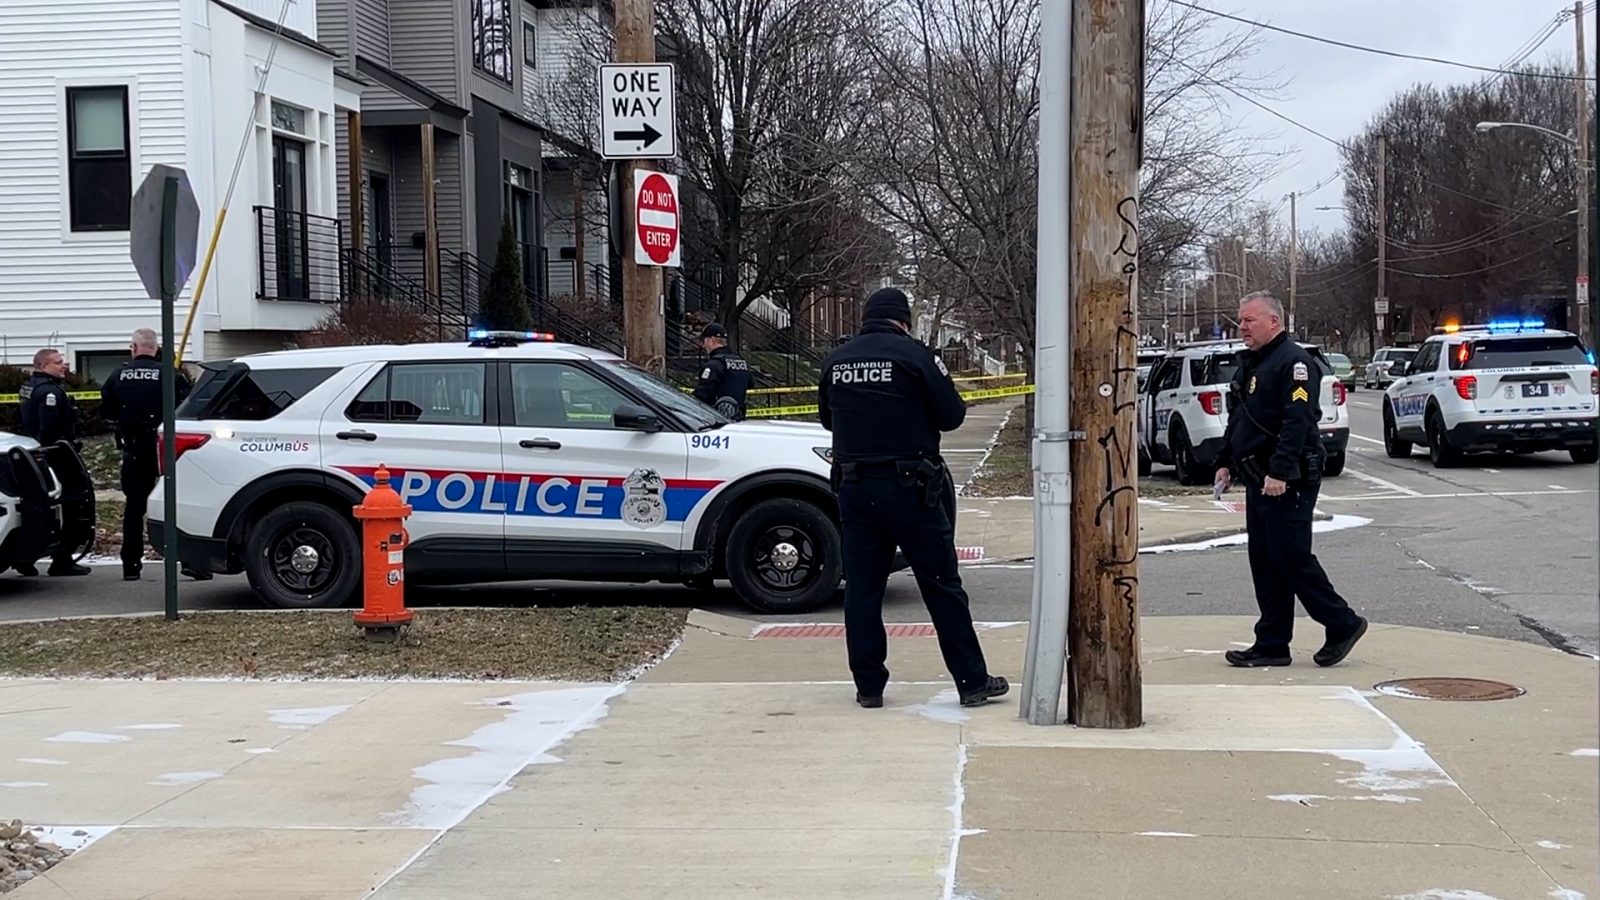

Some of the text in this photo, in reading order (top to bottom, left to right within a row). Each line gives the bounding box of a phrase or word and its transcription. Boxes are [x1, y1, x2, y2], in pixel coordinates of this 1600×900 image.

[613, 72, 660, 93] ONE
[612, 97, 662, 117] WAY
[642, 189, 673, 208] DO NOT
[646, 230, 671, 248] ENTER
[832, 361, 893, 371] COLUMBUS
[120, 372, 160, 381] POLICE
[832, 368, 892, 385] POLICE
[1528, 385, 1542, 396] 34
[240, 441, 309, 452] COLUMBUS
[691, 434, 730, 449] 9041
[400, 471, 609, 515] POLICE
